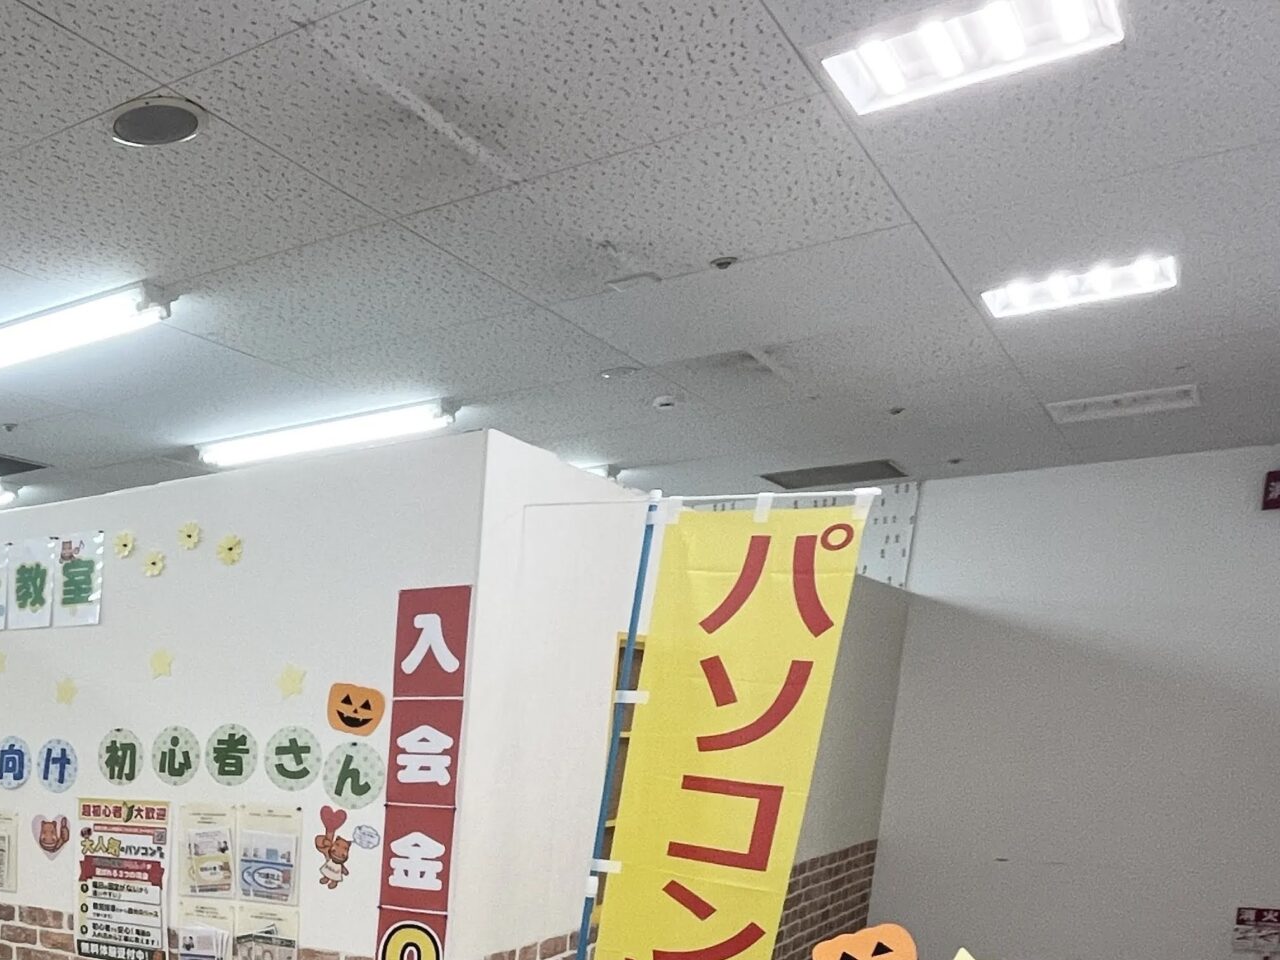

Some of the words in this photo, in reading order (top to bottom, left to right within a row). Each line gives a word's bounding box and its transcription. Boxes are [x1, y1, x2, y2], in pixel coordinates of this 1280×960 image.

[106, 733, 371, 797] 初心者さん
